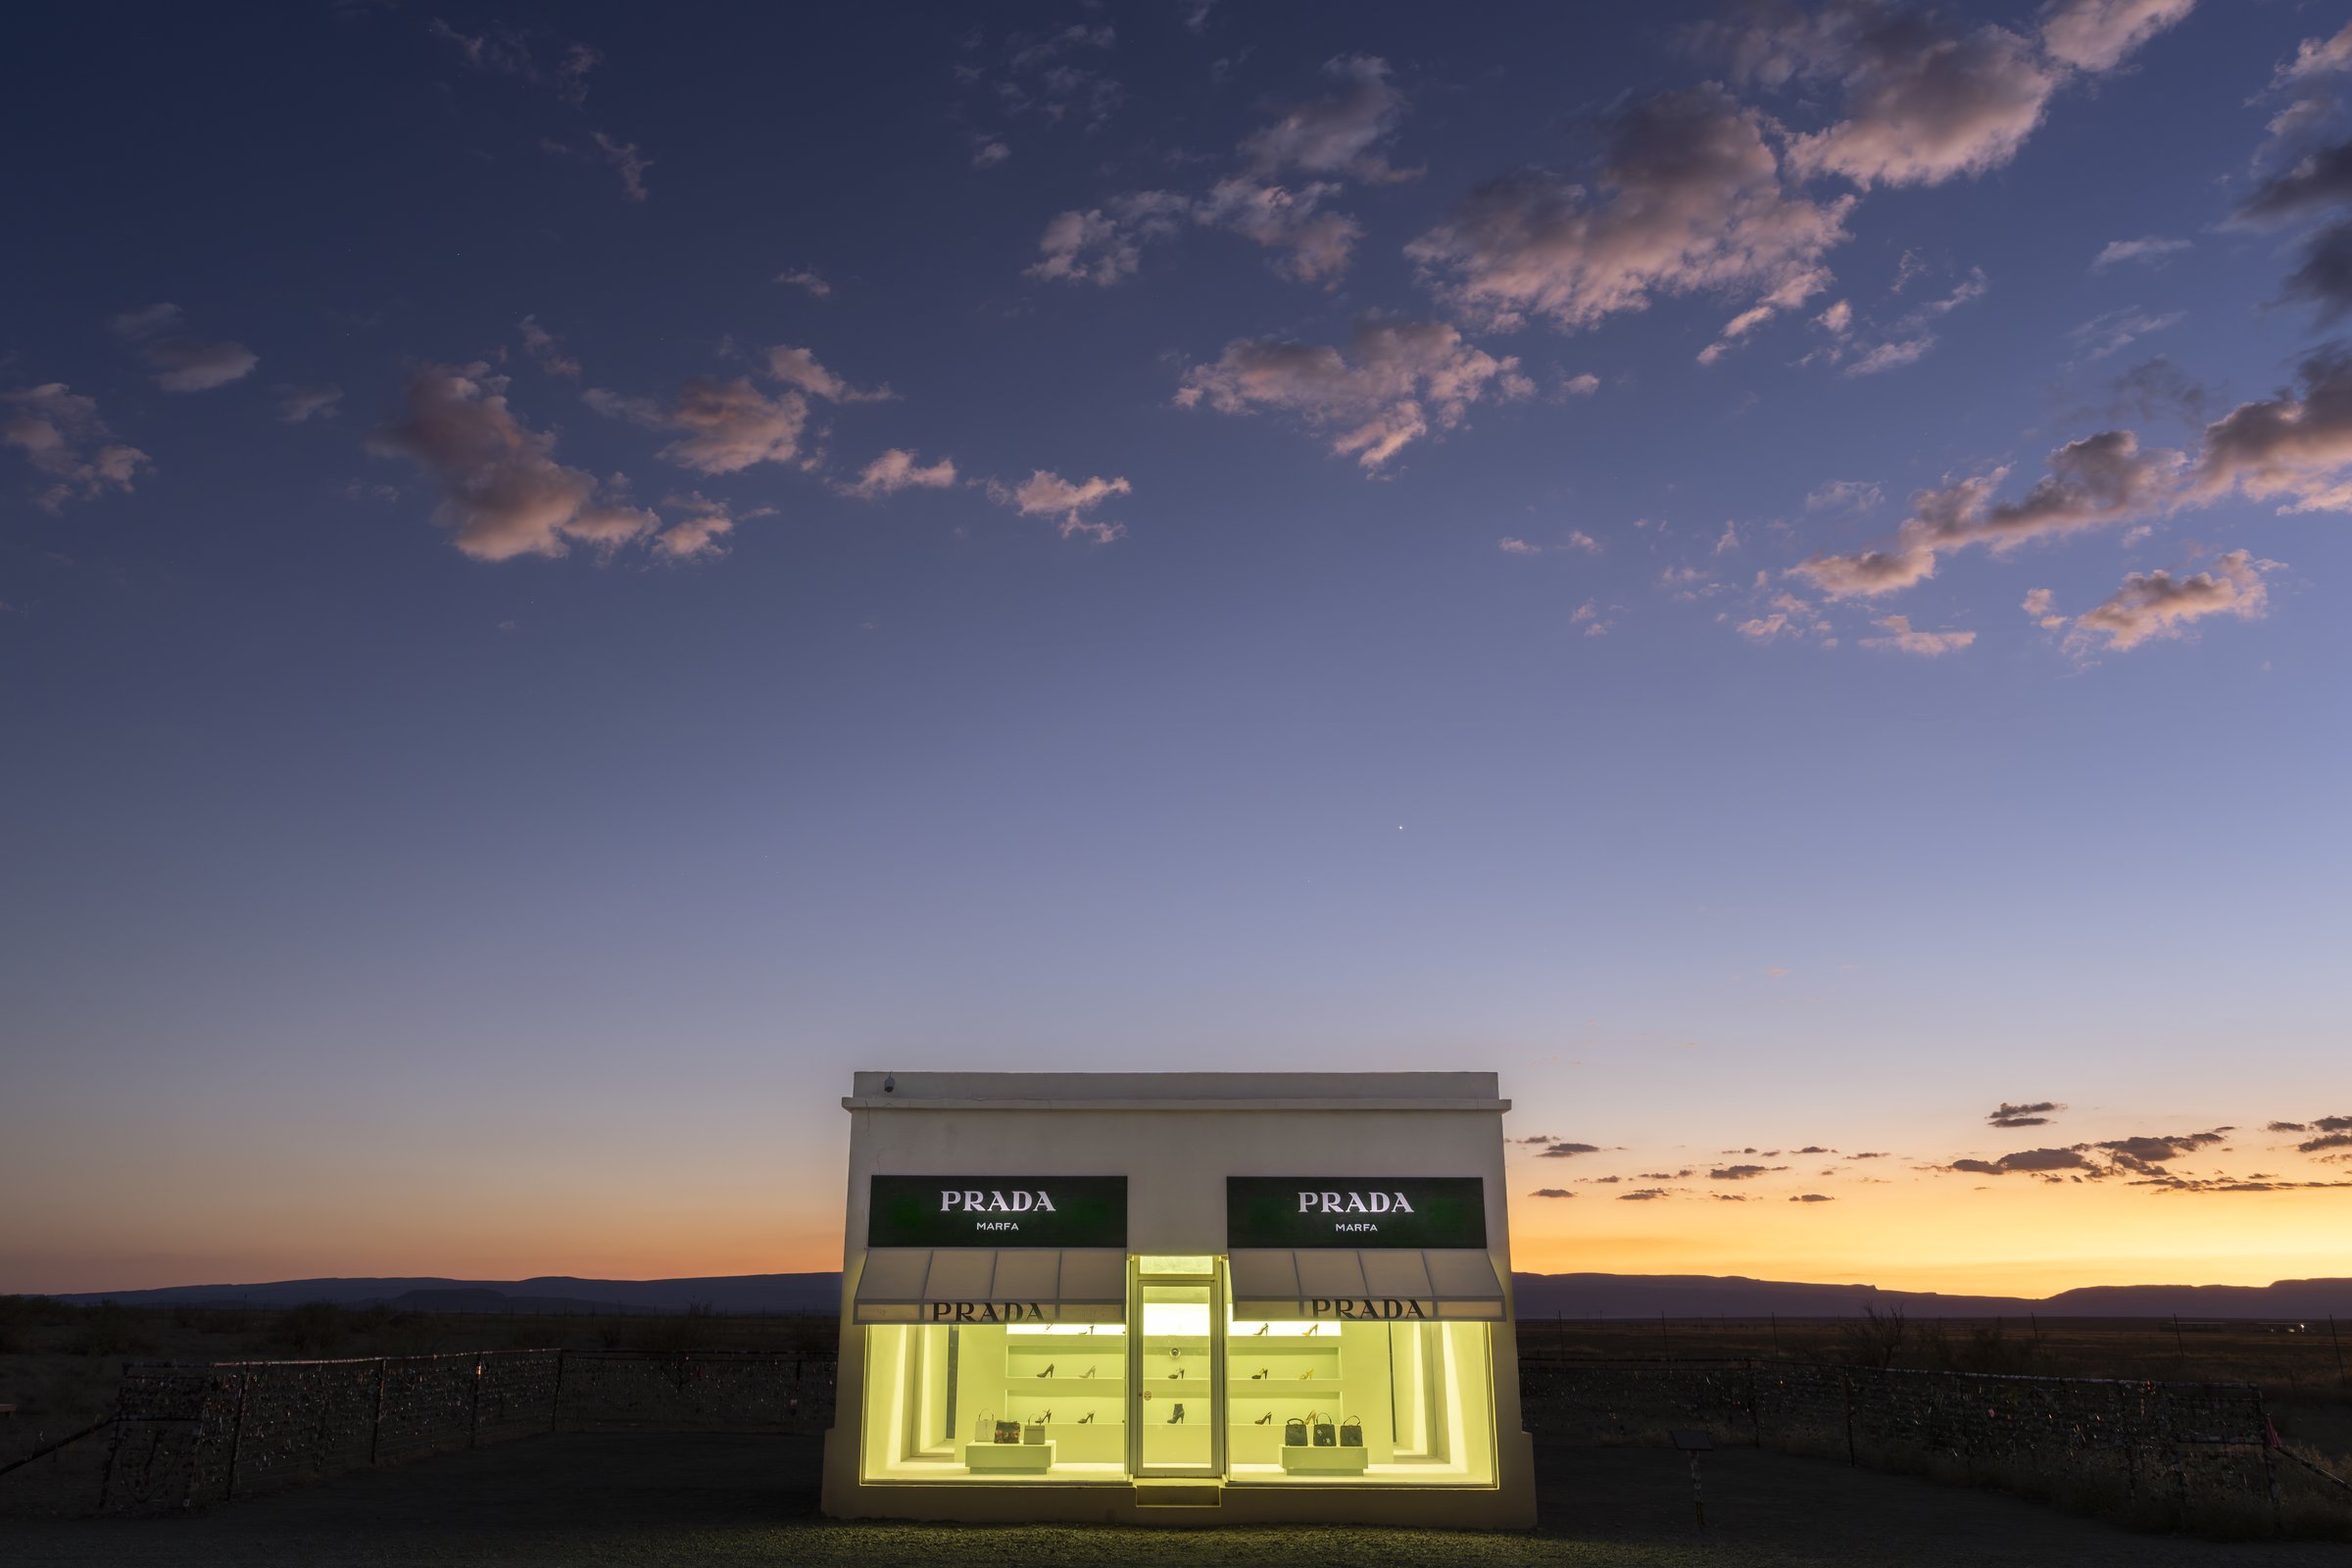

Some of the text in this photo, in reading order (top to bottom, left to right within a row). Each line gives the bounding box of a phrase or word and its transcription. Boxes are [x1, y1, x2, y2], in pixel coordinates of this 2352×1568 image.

[941, 1190, 1056, 1212] PRADA
[1298, 1192, 1415, 1213] PRADA
[976, 1222, 1019, 1231] MARFA
[1335, 1223, 1378, 1232] MARFA
[932, 1301, 1045, 1322] PRADA
[1311, 1298, 1427, 1319] PRADA
